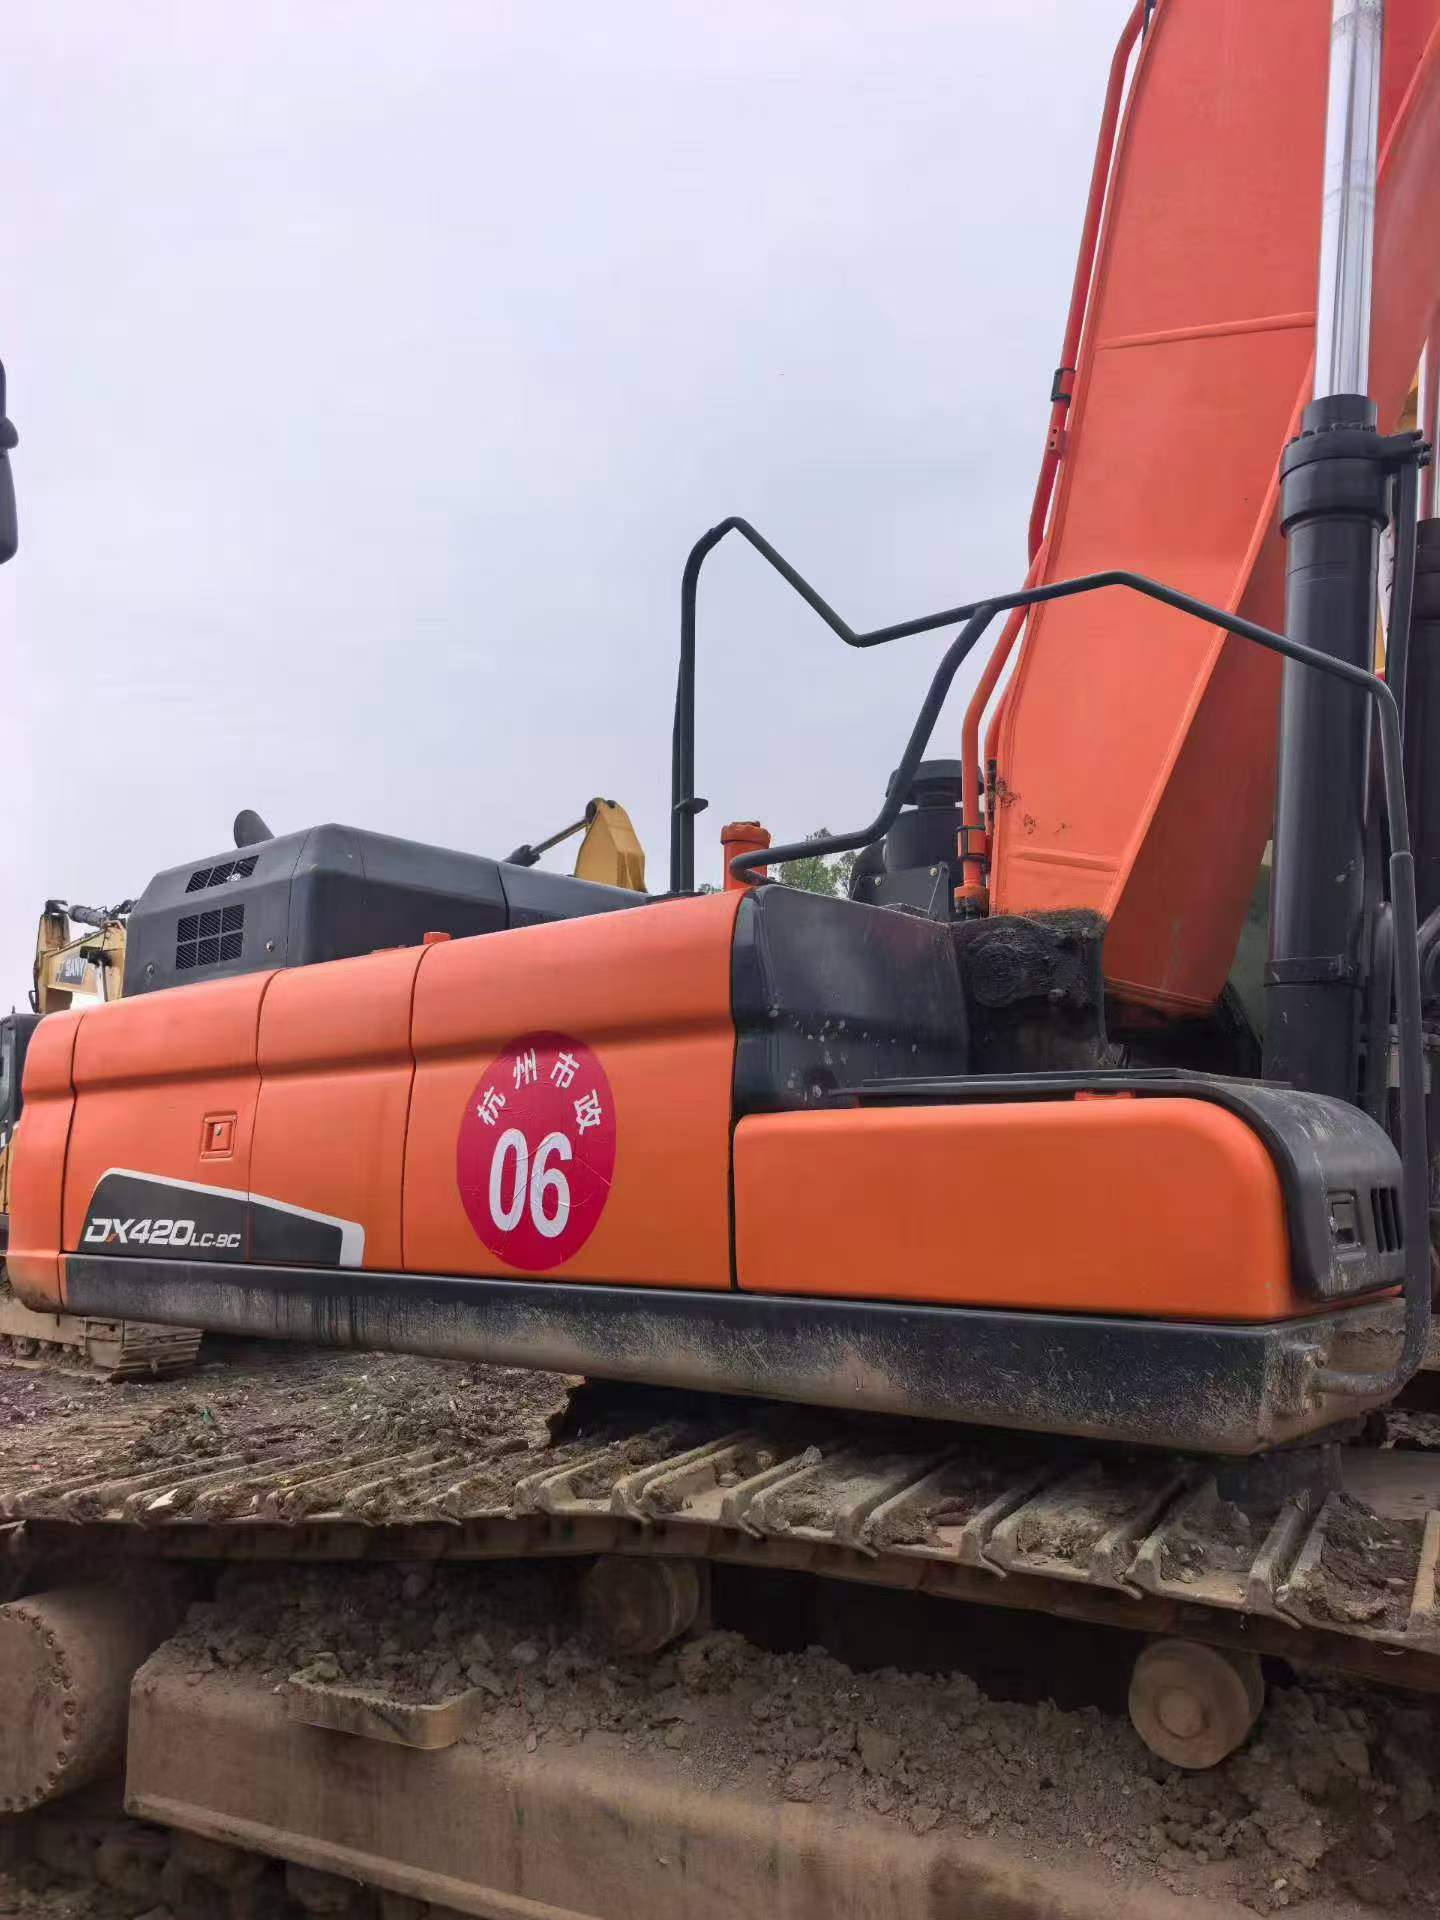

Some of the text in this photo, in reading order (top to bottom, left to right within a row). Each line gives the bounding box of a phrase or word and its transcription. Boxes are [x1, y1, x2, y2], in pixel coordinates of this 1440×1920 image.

[476, 1048, 602, 1135] 杭州市政
[489, 1128, 572, 1238] 06
